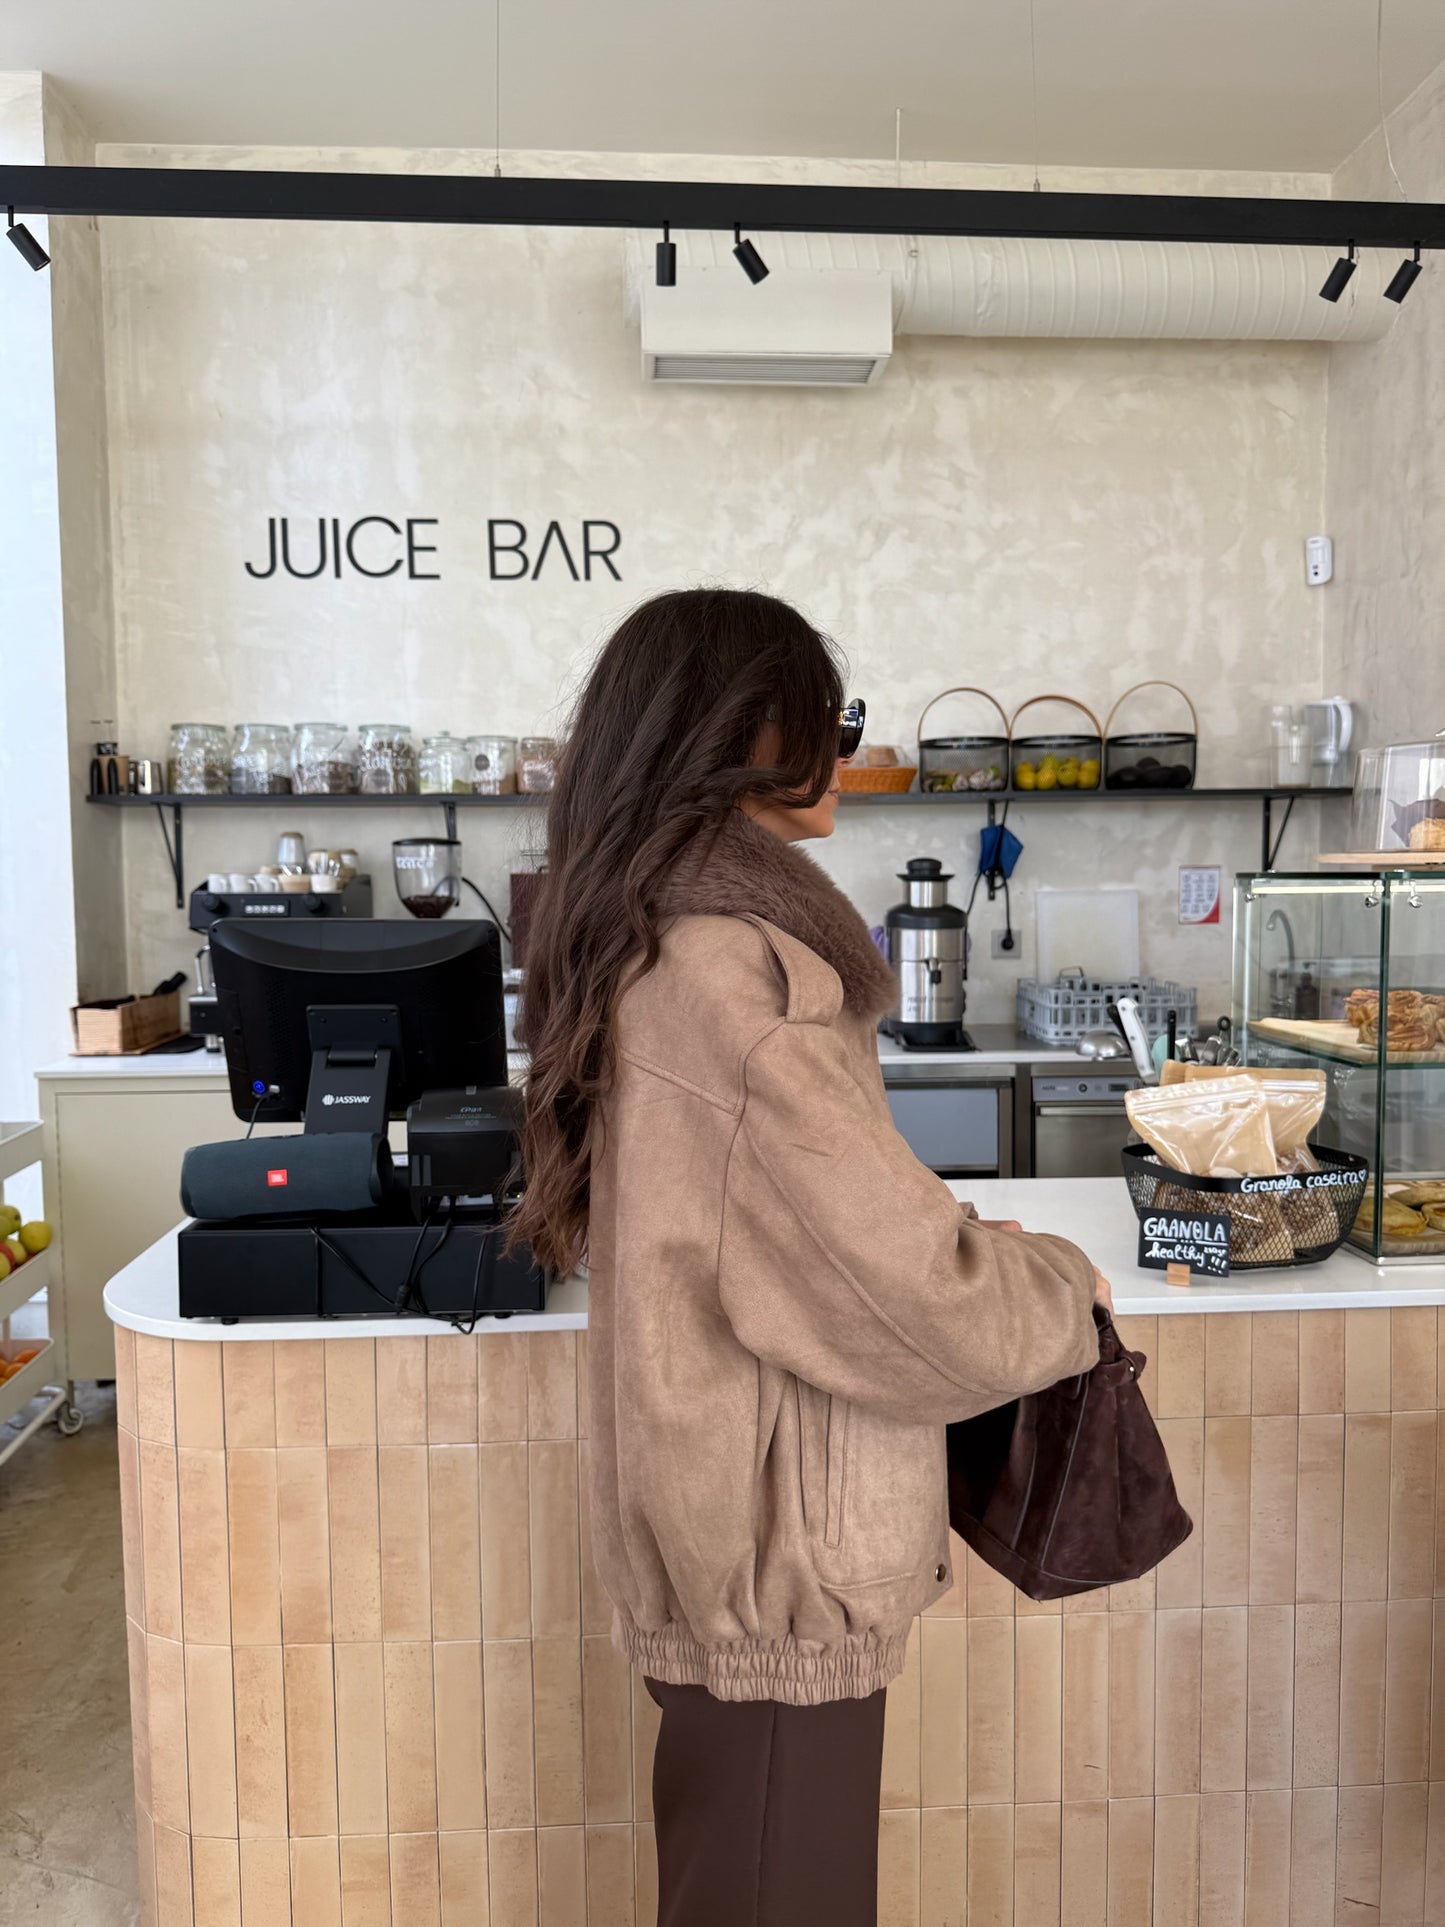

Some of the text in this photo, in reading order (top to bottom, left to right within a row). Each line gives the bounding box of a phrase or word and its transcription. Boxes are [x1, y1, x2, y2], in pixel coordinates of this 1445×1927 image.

[244, 516, 623, 582] JUICE BAR
[334, 1095, 371, 1104] JASSWAY
[1240, 1170, 1359, 1194] Granola caseira
[1143, 1217, 1226, 1241] GRANOLA
[1144, 1241, 1205, 1267] healthy
